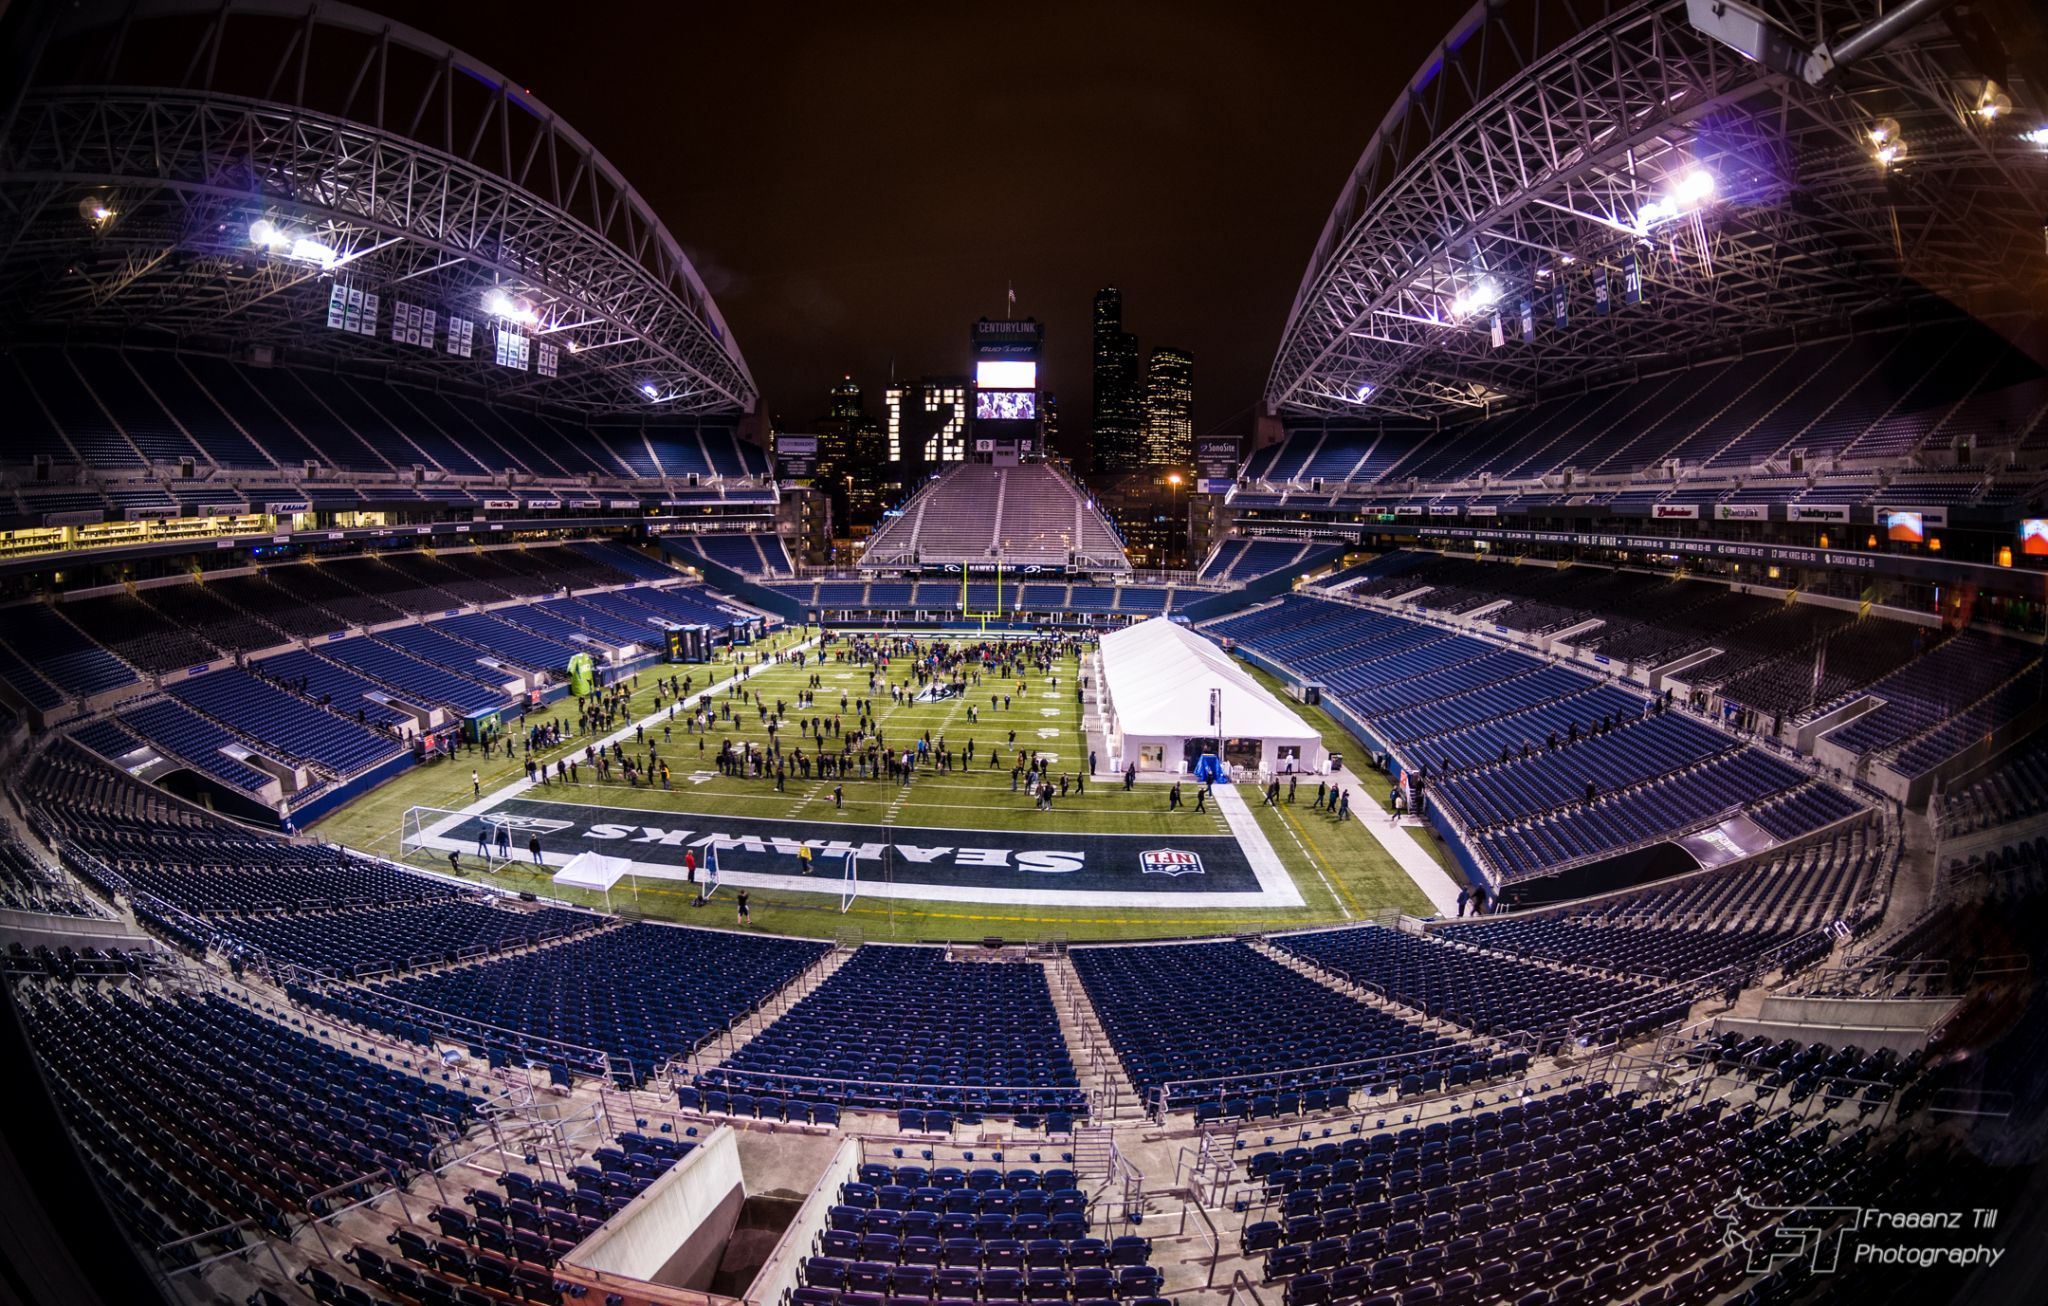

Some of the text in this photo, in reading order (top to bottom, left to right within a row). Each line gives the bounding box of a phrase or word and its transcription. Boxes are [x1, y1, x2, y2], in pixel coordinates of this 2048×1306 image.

[1625, 272, 1637, 293] 71
[1595, 284, 1608, 303] 96
[1556, 301, 1565, 319] 12
[979, 322, 1036, 333] CENTURYLINK
[886, 389, 965, 461] 12
[1208, 443, 1236, 452] SonoSite
[1578, 535, 1590, 544] RING
[1591, 536, 1598, 545] OF
[1600, 536, 1617, 546] HONOR
[1718, 545, 1725, 553] 45
[1771, 549, 1777, 558] 17
[582, 823, 1085, 873] SEAHAWKS
[1147, 852, 1193, 864] NFL
